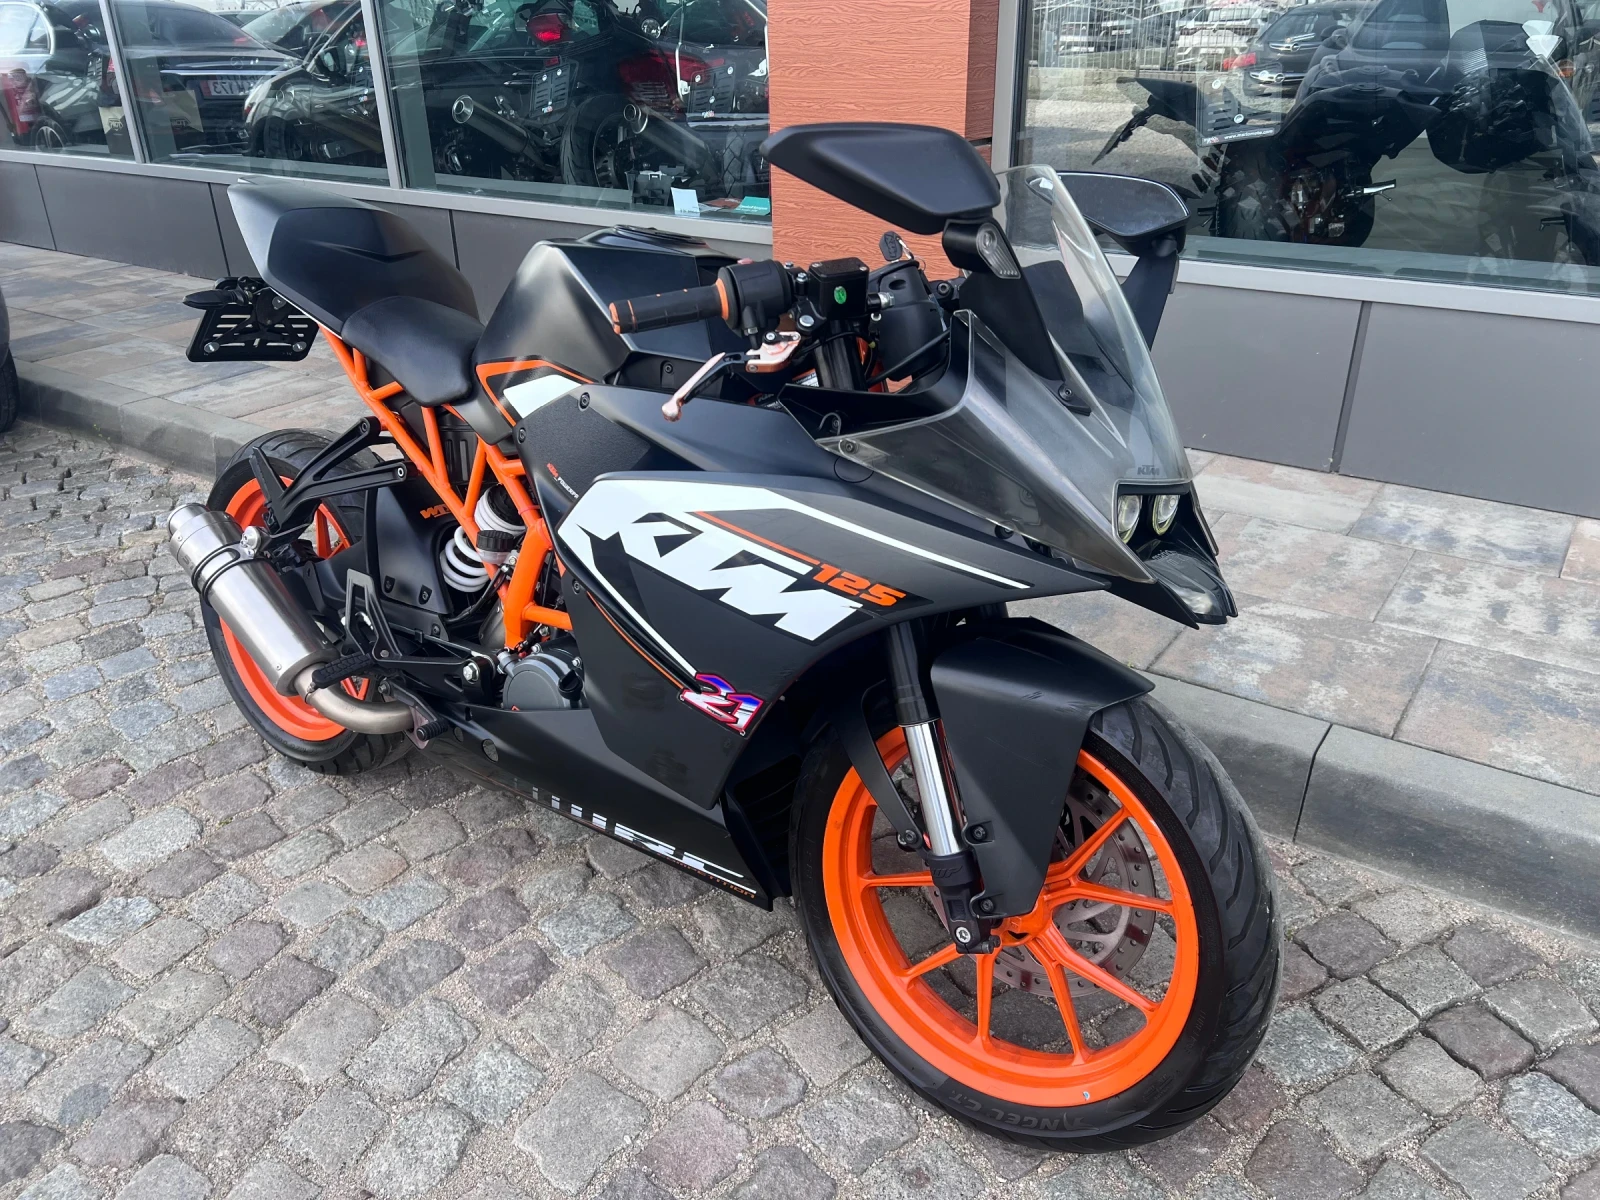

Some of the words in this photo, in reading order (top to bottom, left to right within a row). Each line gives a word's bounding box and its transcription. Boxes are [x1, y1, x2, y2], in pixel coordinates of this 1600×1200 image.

[1137, 464, 1160, 476] KTM
[575, 506, 863, 641] KTM
[813, 562, 907, 607] 125
[680, 672, 765, 732] 21
